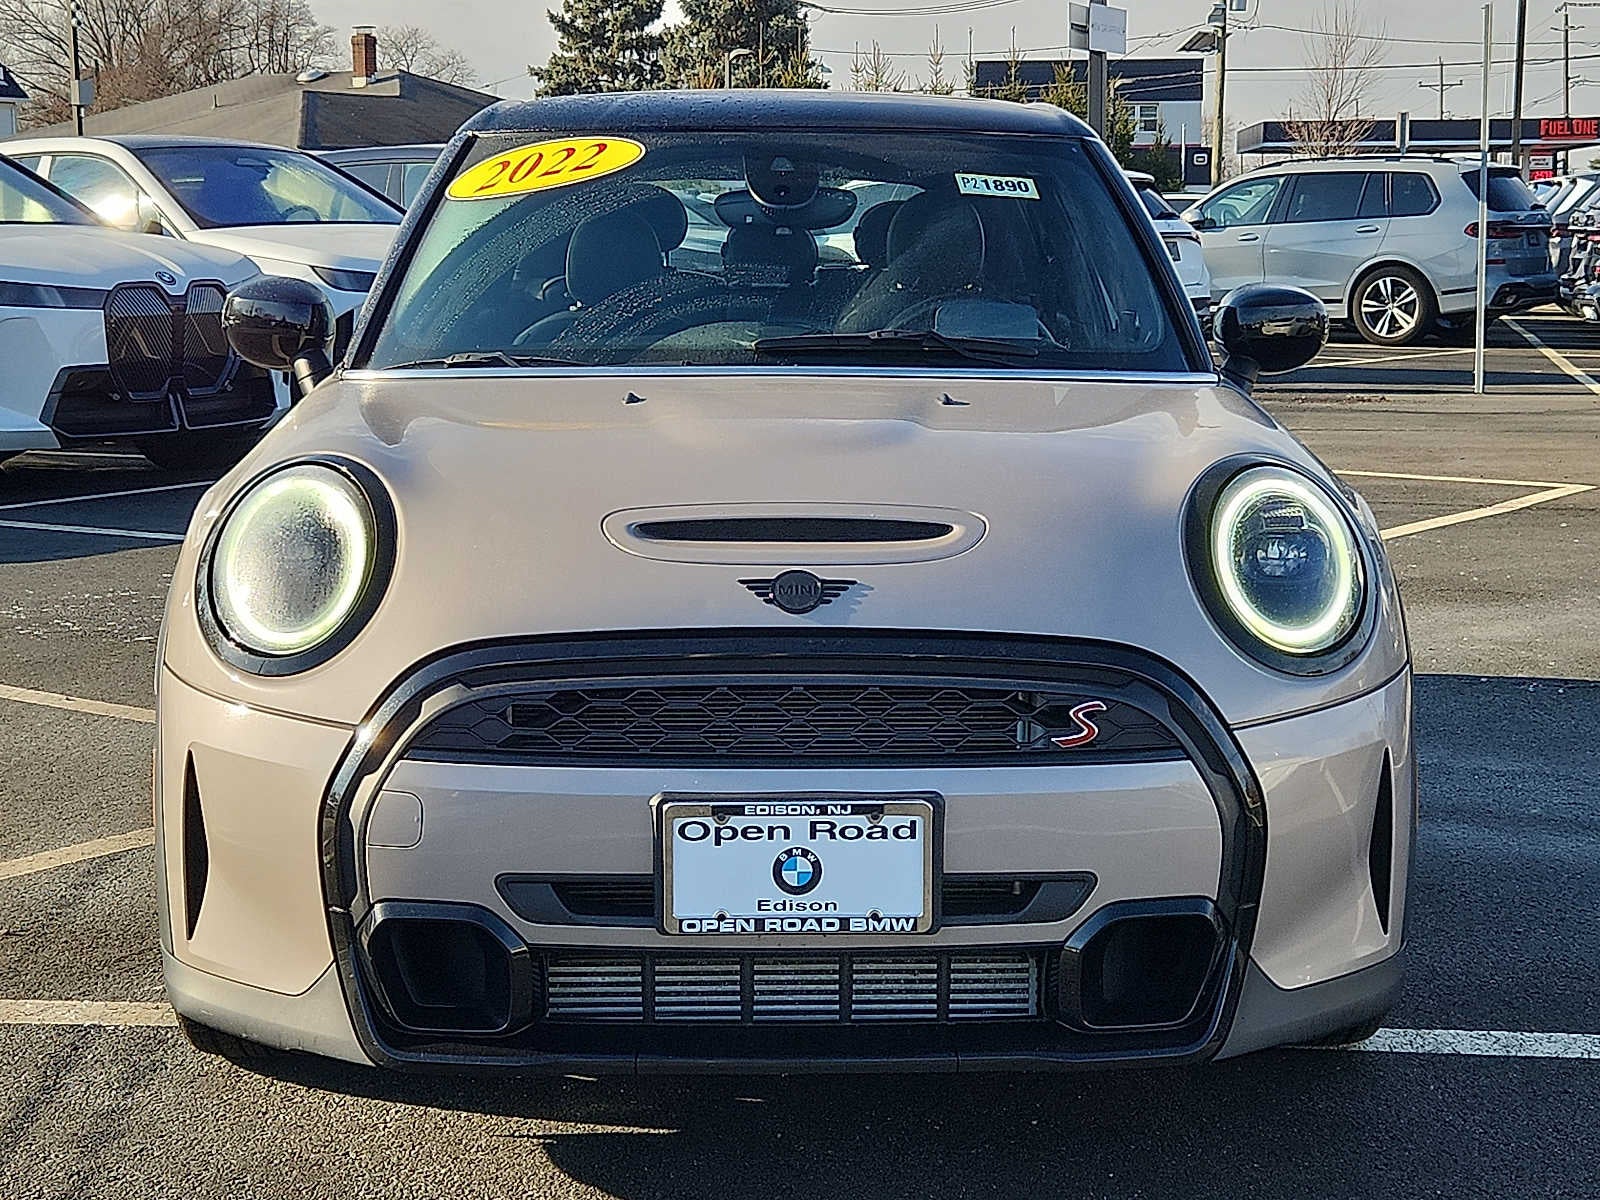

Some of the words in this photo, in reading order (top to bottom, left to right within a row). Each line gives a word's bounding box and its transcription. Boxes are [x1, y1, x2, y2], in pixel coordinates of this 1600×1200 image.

[1540, 119, 1571, 136] FUEL
[1573, 119, 1598, 135] ONE
[473, 143, 608, 193] 2022
[777, 583, 816, 595] MINI
[1051, 700, 1107, 748] S
[744, 805, 821, 815] EDISON,
[827, 805, 852, 815] NJ
[677, 820, 791, 846] Open
[809, 819, 917, 841] Road
[779, 849, 817, 862] BMW
[757, 899, 837, 912] Edison
[681, 918, 756, 933] OPEN
[764, 918, 840, 932] ROAD
[850, 917, 915, 932] BMW
